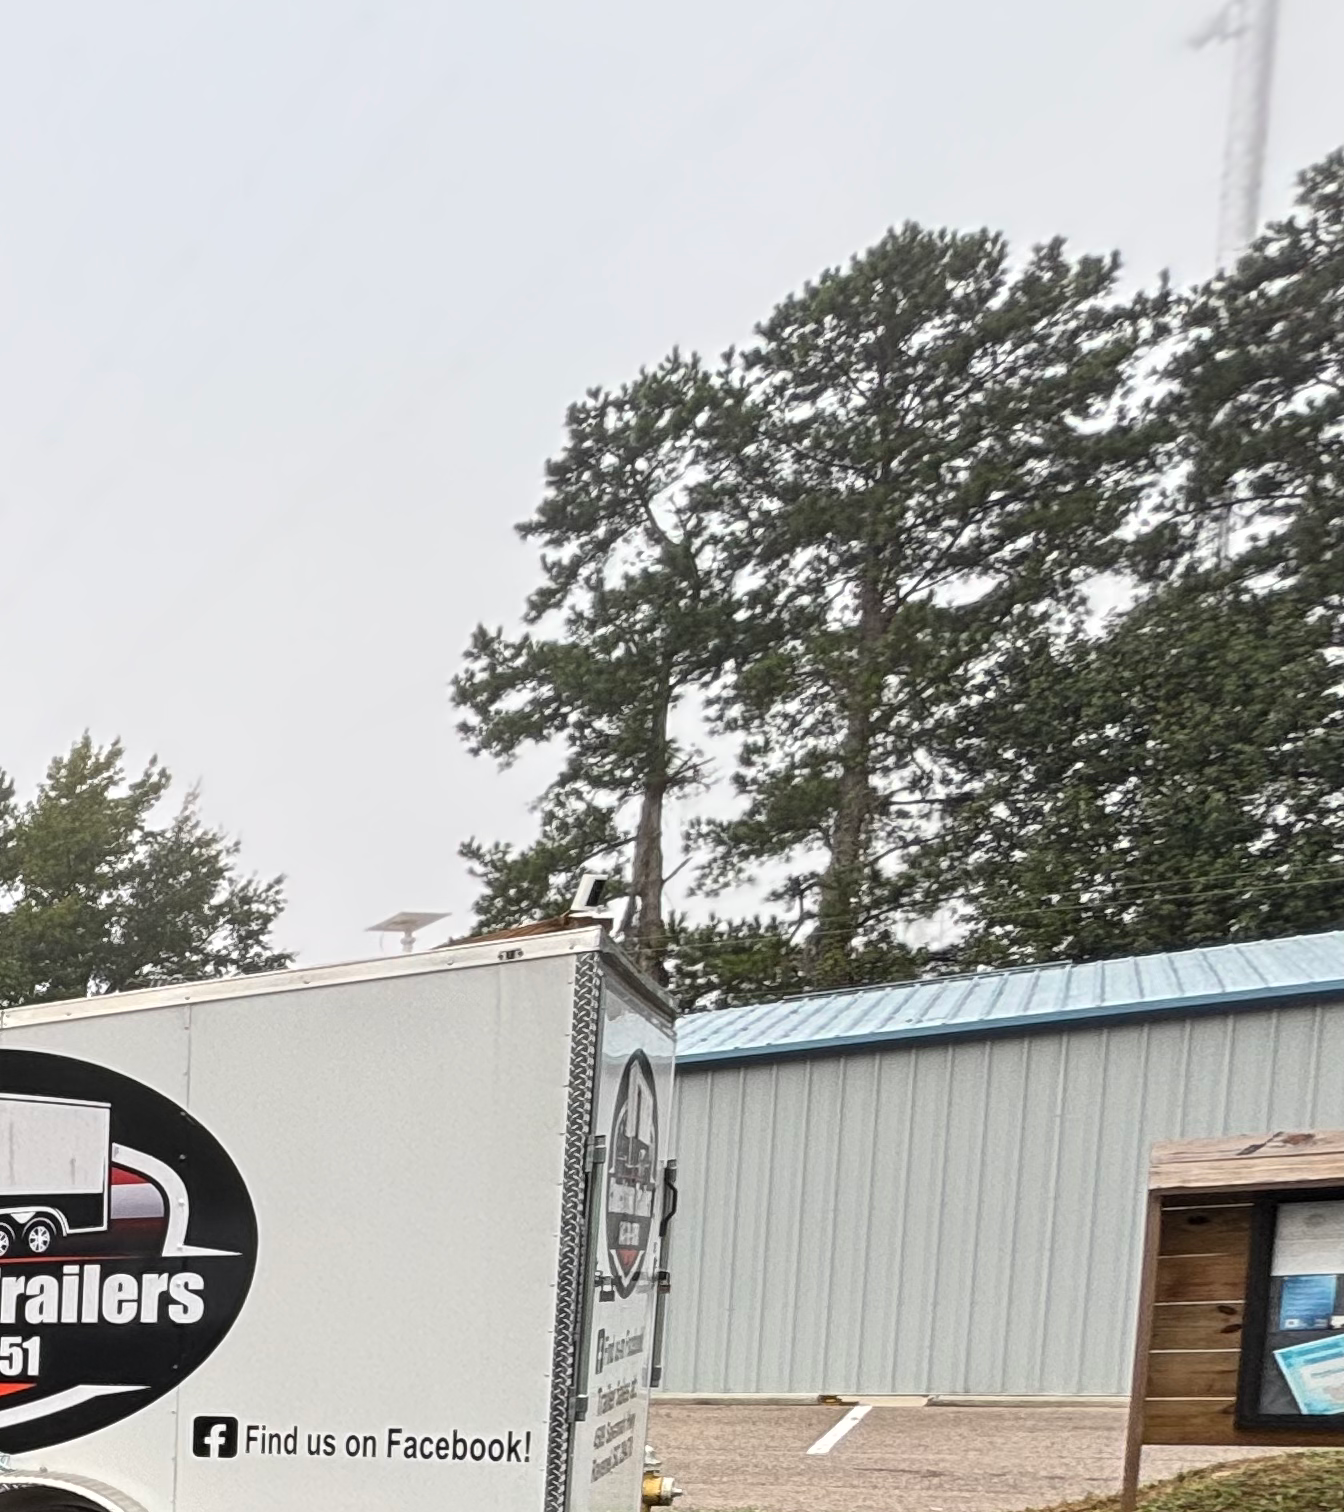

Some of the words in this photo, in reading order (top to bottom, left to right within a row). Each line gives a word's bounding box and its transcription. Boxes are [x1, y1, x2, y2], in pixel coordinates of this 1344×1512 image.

[245, 1424, 297, 1455] Find
[307, 1433, 337, 1457] us
[345, 1435, 377, 1458] on
[386, 1428, 532, 1464] Facebook!
